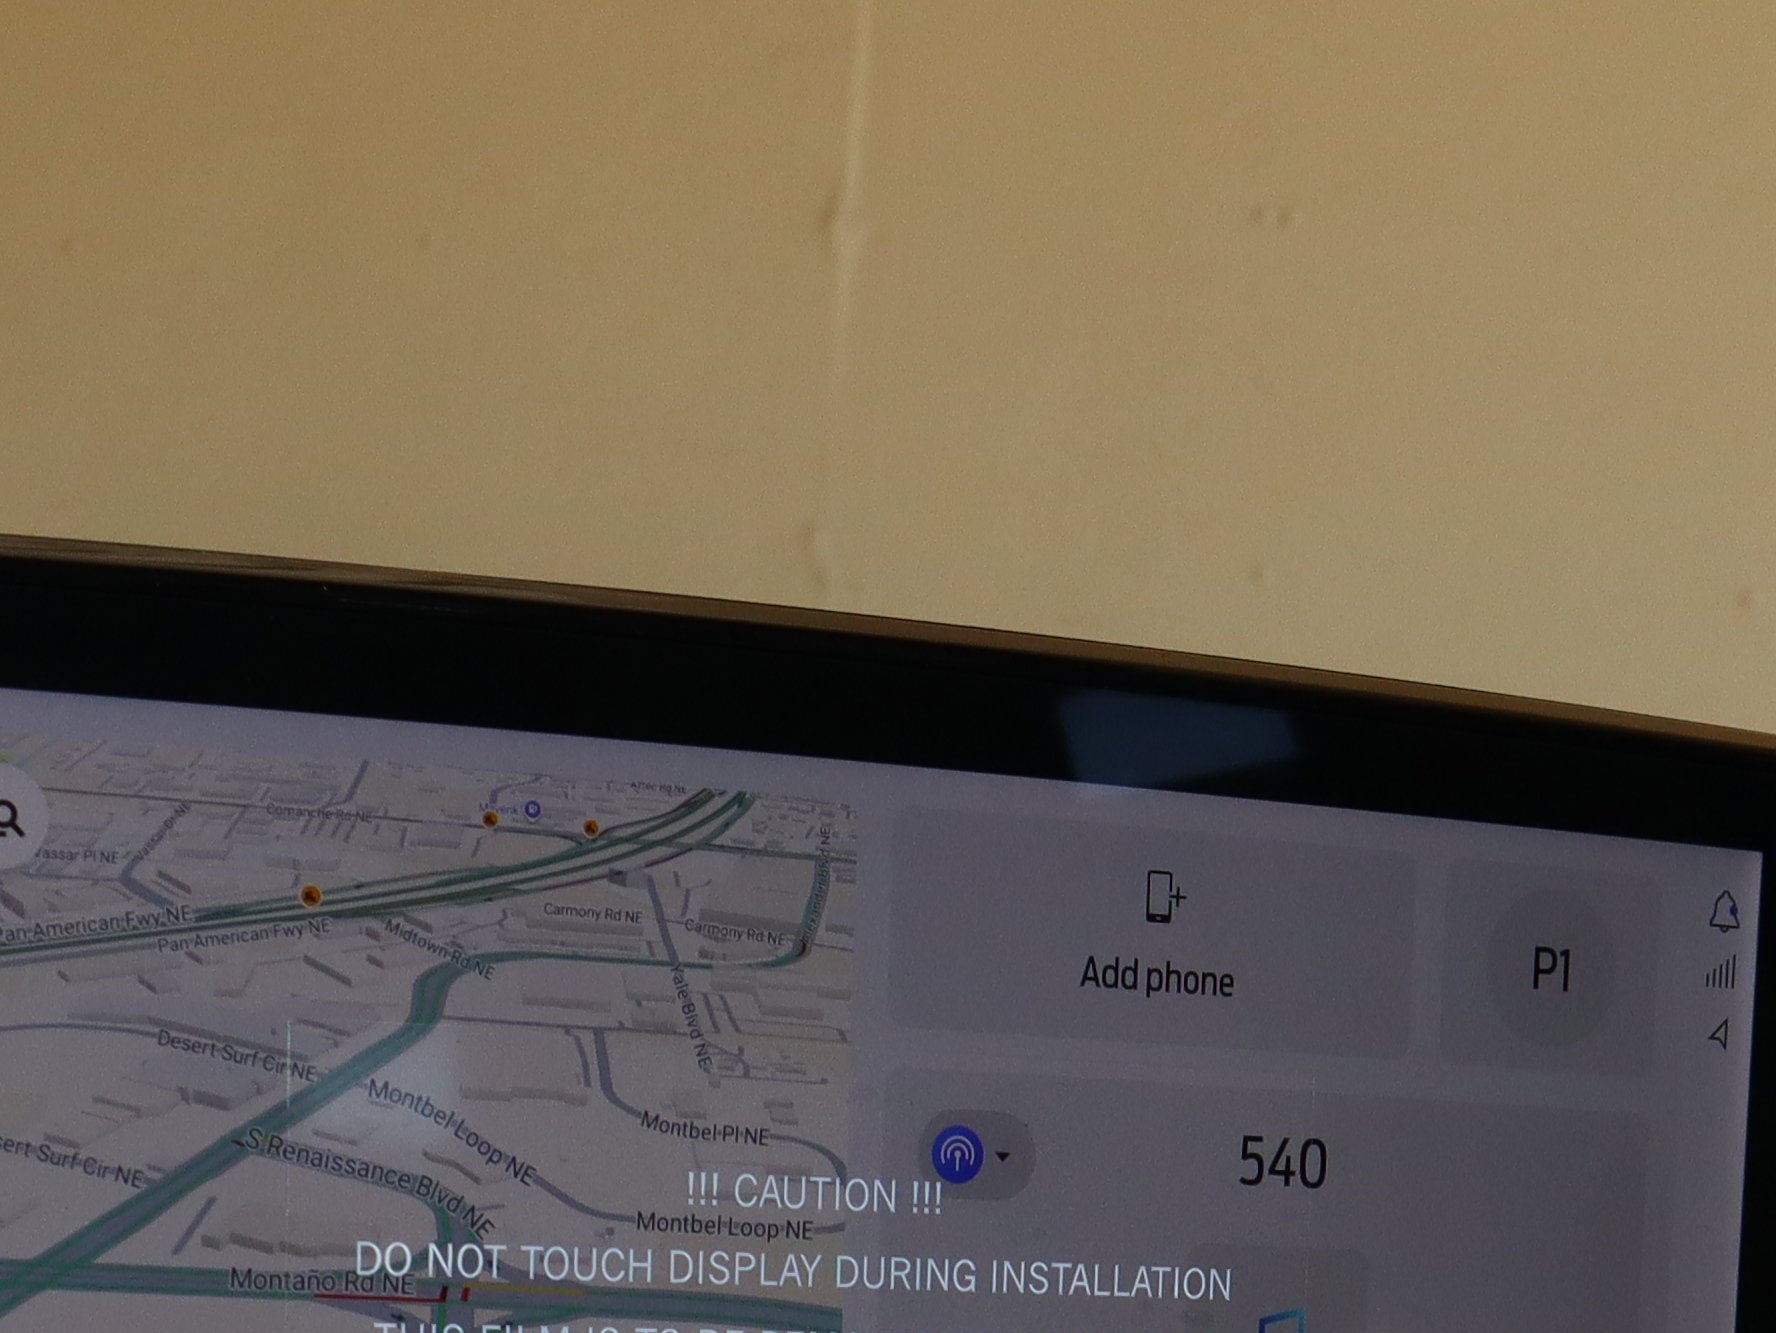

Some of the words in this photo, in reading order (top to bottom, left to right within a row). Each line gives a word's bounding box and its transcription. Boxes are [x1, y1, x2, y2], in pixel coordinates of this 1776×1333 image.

[355, 812, 373, 823] NE
[100, 851, 119, 865] NE
[32, 914, 122, 939] American
[125, 911, 162, 935] Fwy
[166, 904, 192, 923] NE
[544, 903, 601, 922] Carmony
[605, 908, 623, 921] Rd
[625, 910, 643, 923] NE
[685, 918, 743, 940] Carmony
[747, 929, 764, 943] Rd
[767, 932, 786, 946] NE
[157, 936, 191, 952] Pan
[194, 929, 269, 950] American
[273, 923, 306, 941] Fwy
[309, 920, 331, 936] NE
[385, 918, 450, 958] Midtown
[450, 946, 472, 970] Rd
[473, 960, 496, 981] NE
[1080, 955, 1139, 990] Add
[1146, 960, 1235, 998] phone
[1533, 945, 1570, 992] P1
[671, 962, 689, 1000] Yale
[681, 1000, 704, 1041] Blvd
[693, 1042, 713, 1071] NE
[157, 1029, 216, 1058] Desert
[221, 1043, 263, 1067] Surf
[263, 1055, 288, 1076] Cir
[291, 1060, 318, 1083] NE
[368, 1078, 455, 1129] Montbel
[454, 1114, 503, 1166] Loop
[505, 1154, 538, 1187] NE
[640, 1109, 718, 1142] Montbel
[722, 1124, 740, 1143] Pl
[744, 1127, 770, 1146] NE
[37, 1144, 80, 1170] Surf
[83, 1156, 111, 1180] Cir
[114, 1165, 146, 1189] NE
[1239, 1135, 1327, 1189] 540
[244, 1128, 264, 1151] S
[266, 1134, 413, 1189] Renaissance
[414, 1175, 464, 1214] Blvd
[463, 1205, 496, 1240] NE
[733, 1172, 897, 1212] CAUTION
[636, 1211, 723, 1236] Montbel
[727, 1216, 781, 1243] Loop
[786, 1220, 814, 1240] NE
[230, 1267, 335, 1292] Montaño
[344, 1270, 374, 1292] Rd
[382, 1272, 415, 1295] NE
[355, 1240, 413, 1277] DO
[427, 1243, 508, 1279] NOT
[521, 1245, 653, 1284] TOUCH
[669, 1249, 823, 1288] DISPLAY
[835, 1254, 977, 1293] DURING
[990, 1260, 1233, 1301] INSTALLATION
